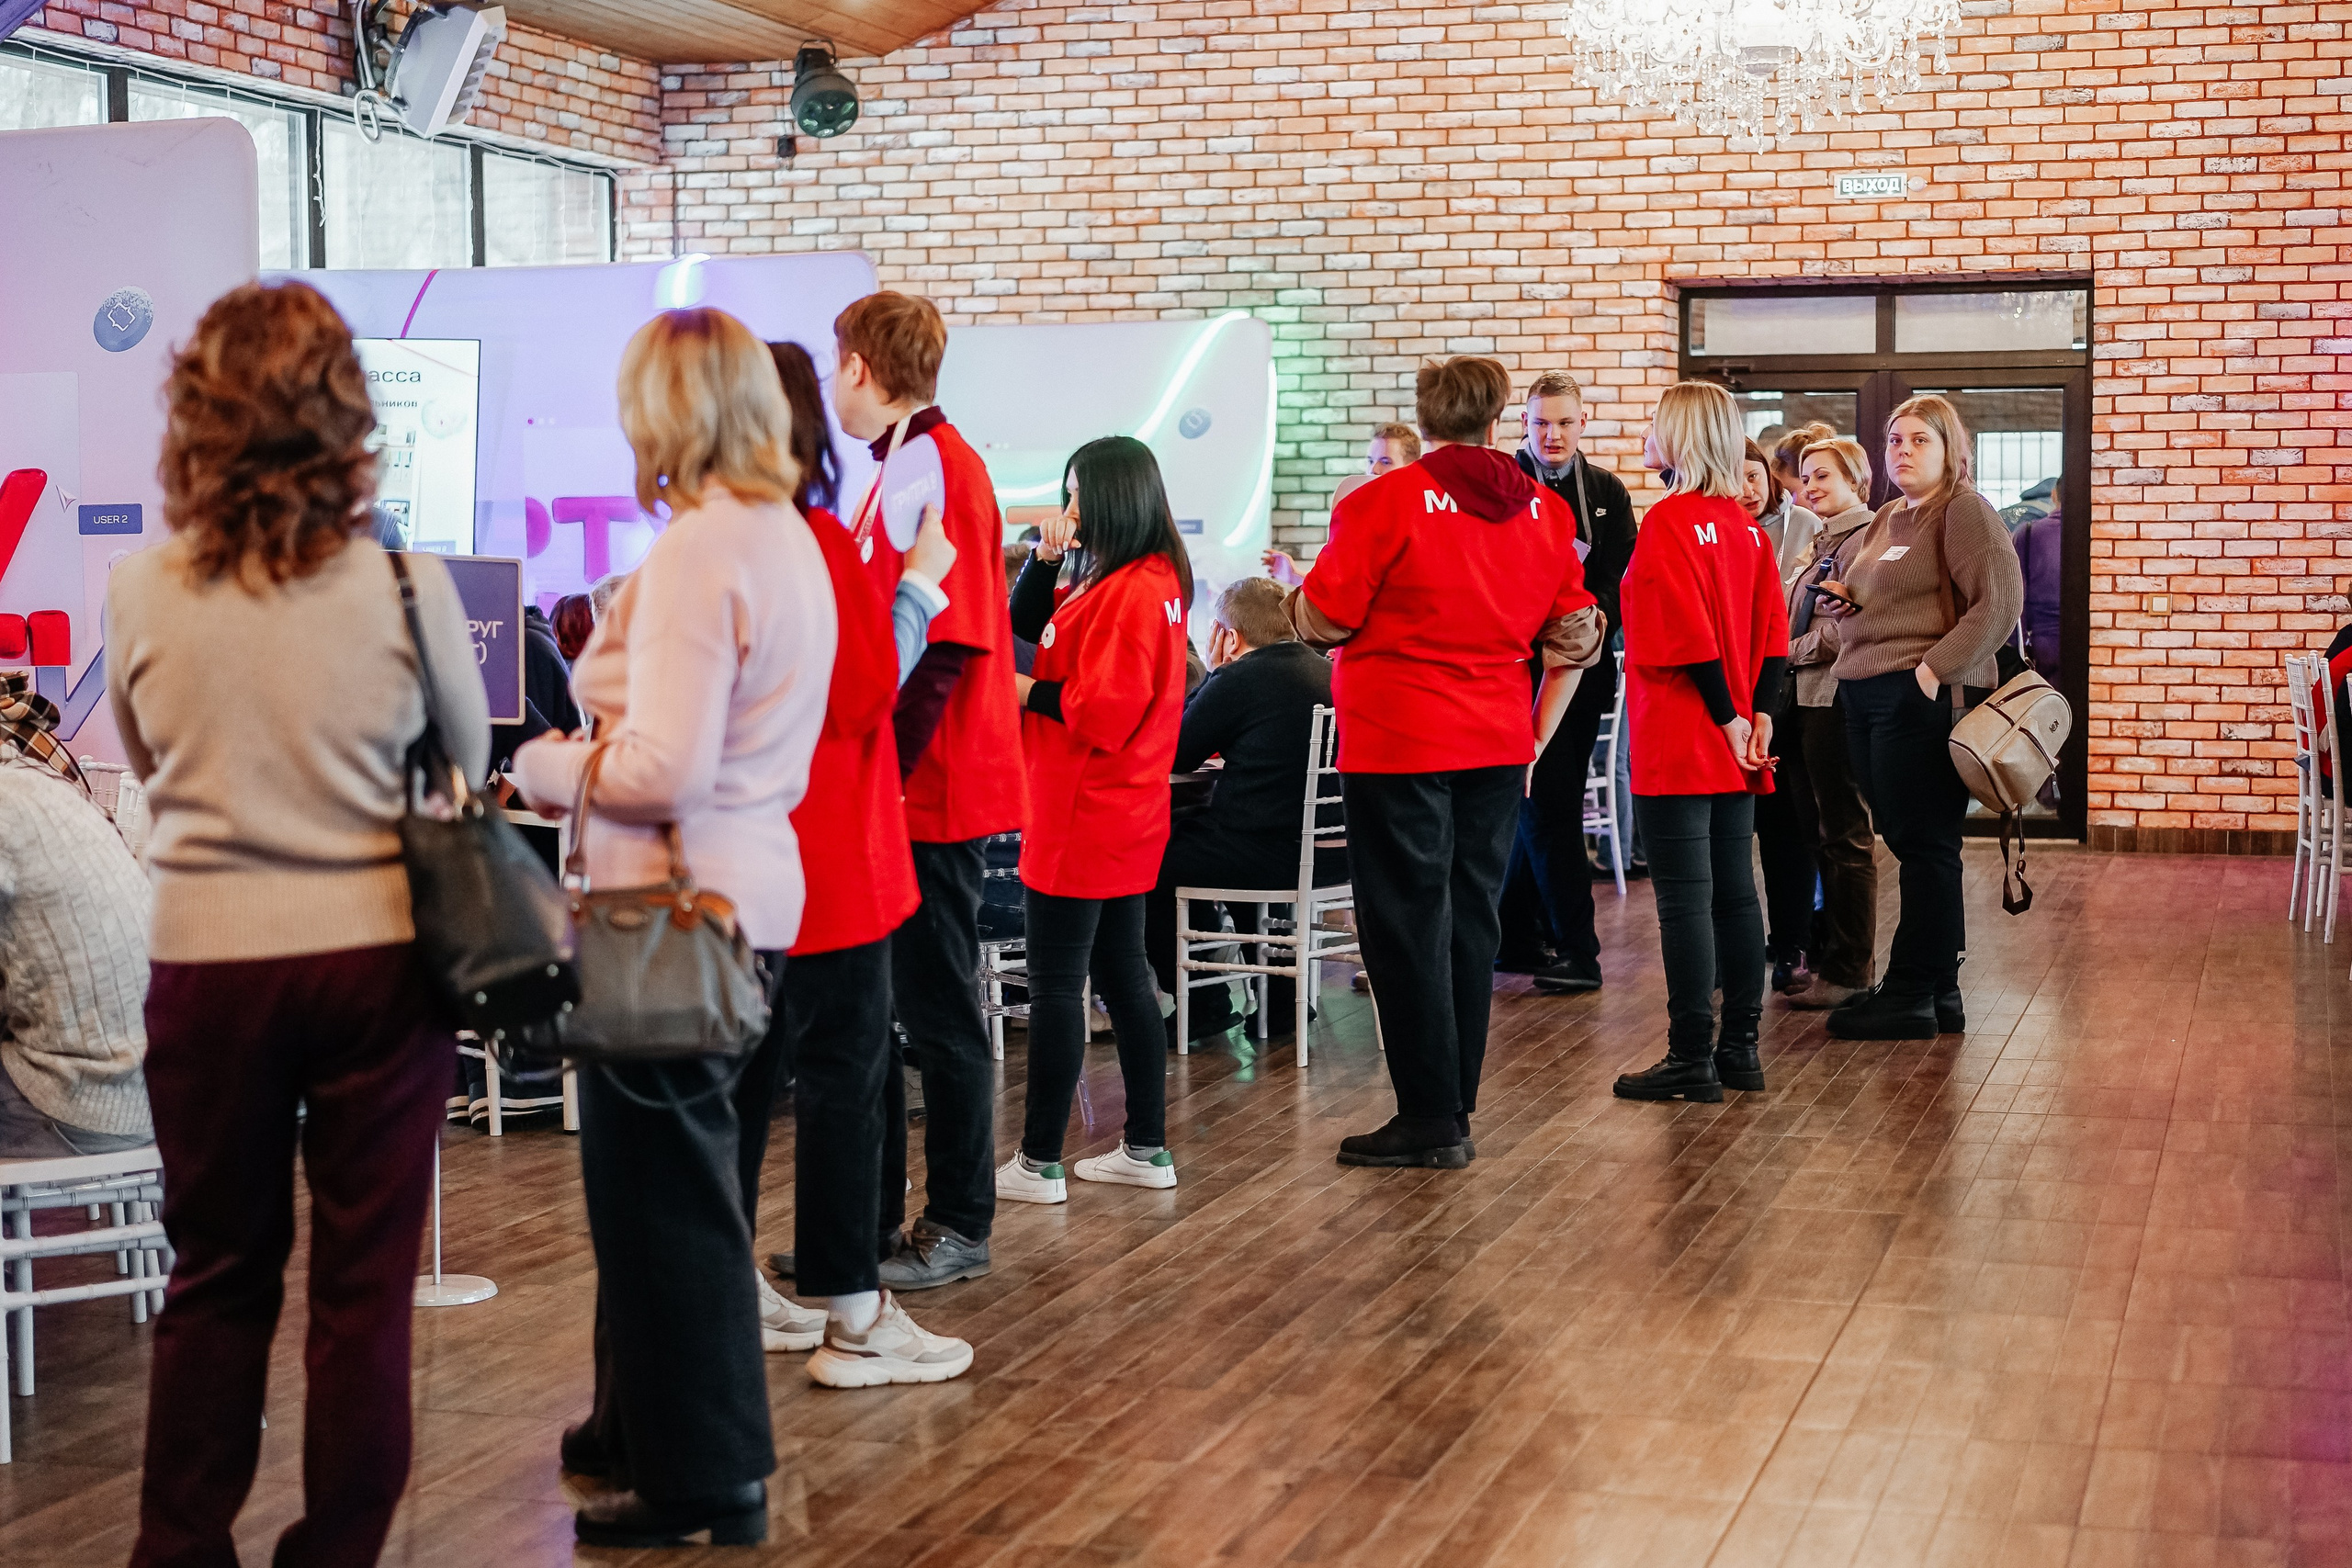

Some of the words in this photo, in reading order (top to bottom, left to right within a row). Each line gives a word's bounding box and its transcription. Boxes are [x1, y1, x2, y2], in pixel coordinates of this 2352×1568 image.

[1842, 178, 1900, 193] ВЫХОД
[368, 370, 421, 382] асса
[93, 515, 119, 525] USER
[121, 514, 128, 524] 2
[467, 620, 503, 638] РУГ
